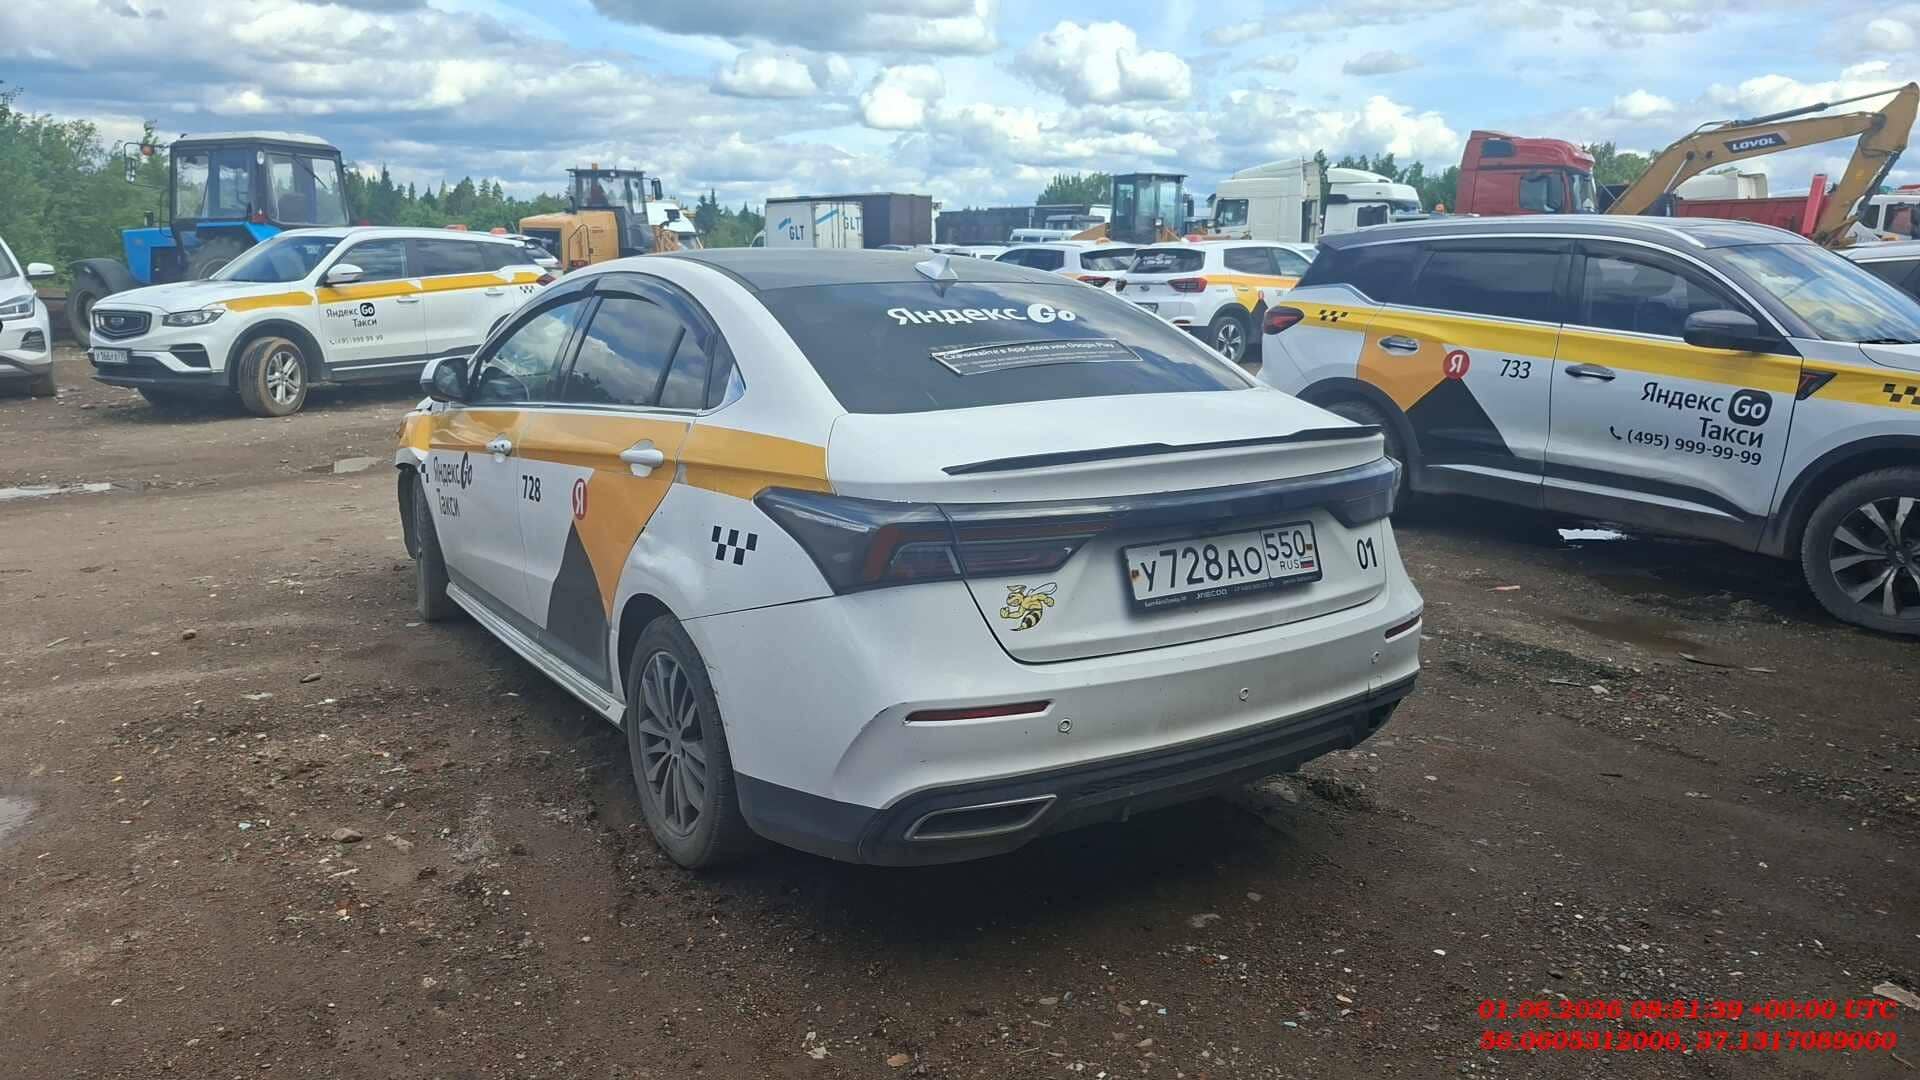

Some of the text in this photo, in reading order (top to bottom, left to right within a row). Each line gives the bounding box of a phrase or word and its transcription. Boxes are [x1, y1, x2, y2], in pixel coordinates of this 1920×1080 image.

[1731, 137, 1777, 151] LOVOL
[789, 225, 804, 240] GLT
[844, 216, 860, 230] GLT
[360, 303, 375, 316] Go
[887, 303, 1077, 326] Яндекс Go
[353, 318, 377, 328] Такси
[1499, 358, 1532, 380] 733
[1640, 381, 1768, 421] Яндекс Go
[1699, 416, 1764, 449] Такси
[1626, 428, 1762, 466] (495) 999-99-99
[433, 453, 473, 489] Яндекс Go
[522, 475, 541, 502] 728
[436, 487, 460, 517] Такси
[1263, 529, 1306, 561] 550
[1356, 537, 1378, 570] 01
[1279, 558, 1300, 571] RUS
